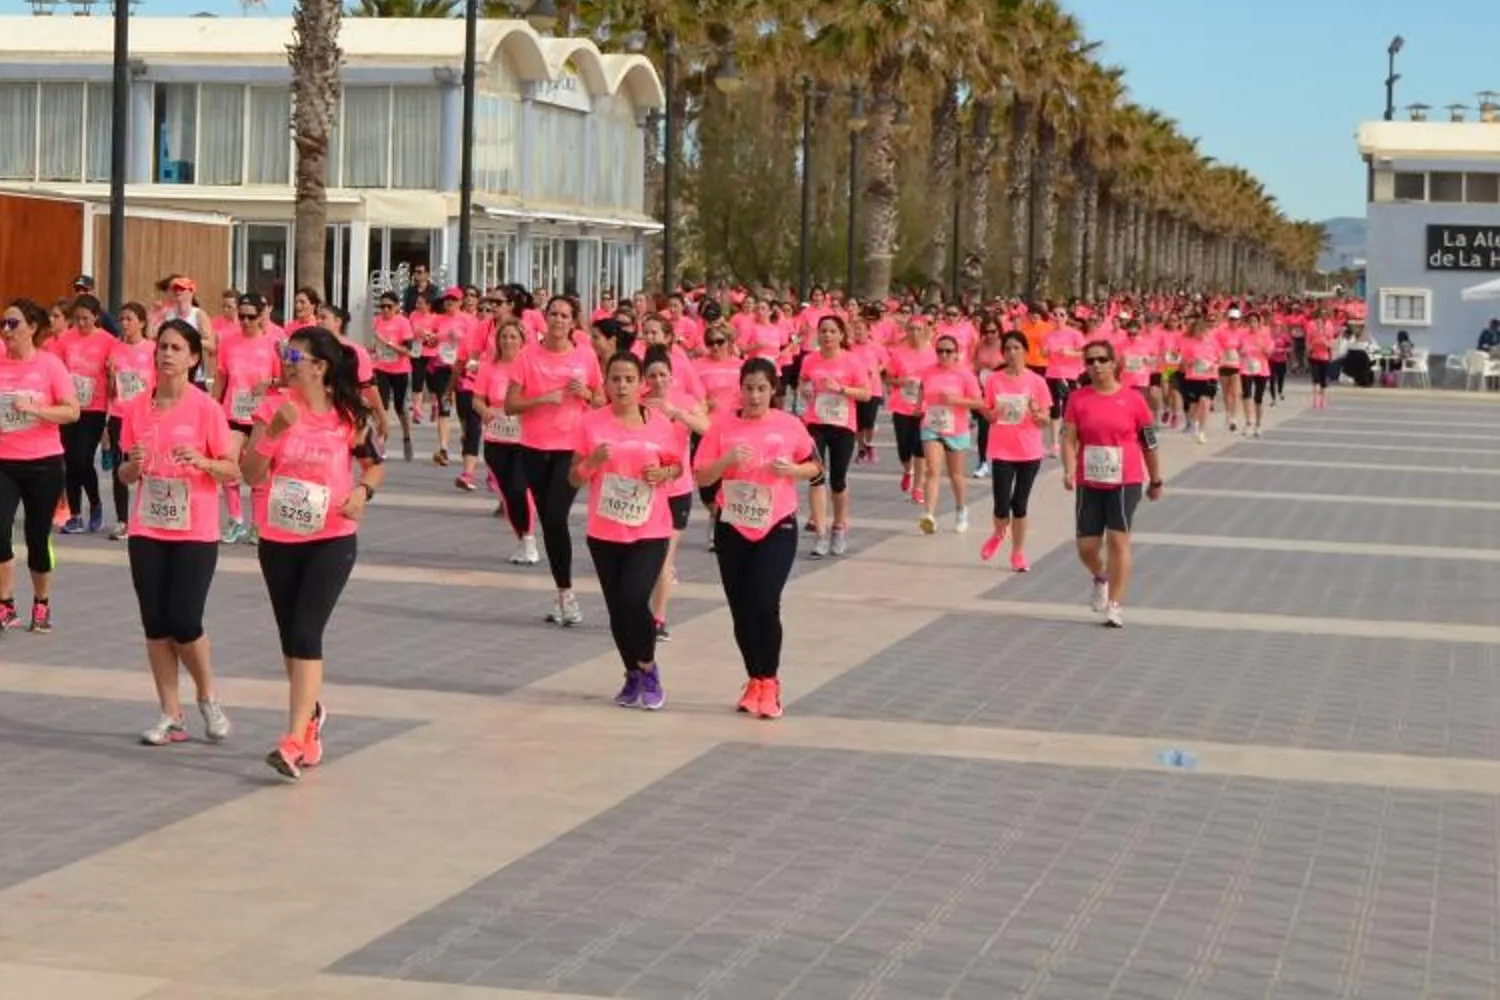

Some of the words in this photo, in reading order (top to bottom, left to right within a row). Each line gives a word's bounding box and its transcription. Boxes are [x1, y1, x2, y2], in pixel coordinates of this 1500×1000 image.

[1443, 230, 1467, 247] La
[1429, 248, 1455, 267] de
[1459, 249, 1481, 267] La
[280, 505, 312, 523] 5259
